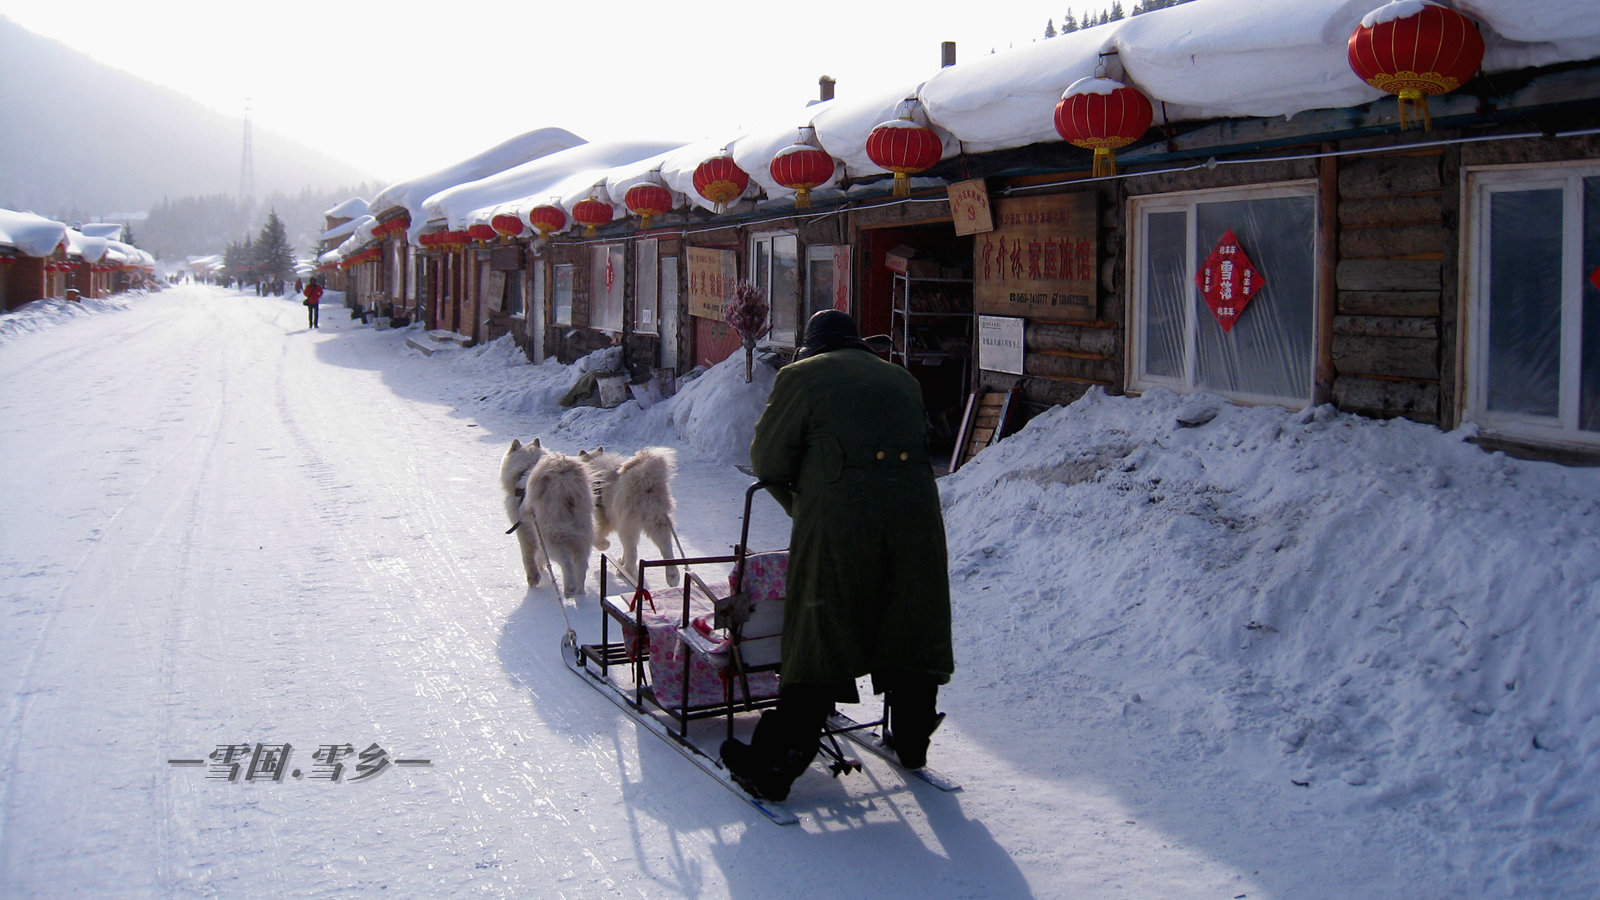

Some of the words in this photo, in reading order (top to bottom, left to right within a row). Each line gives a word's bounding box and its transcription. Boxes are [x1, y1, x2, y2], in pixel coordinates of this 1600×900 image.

[1219, 245, 1236, 255] 兆丰年
[1219, 260, 1233, 300] 雪花
[1243, 269, 1251, 295] 兆丰年
[1217, 306, 1235, 316] 兆丰年
